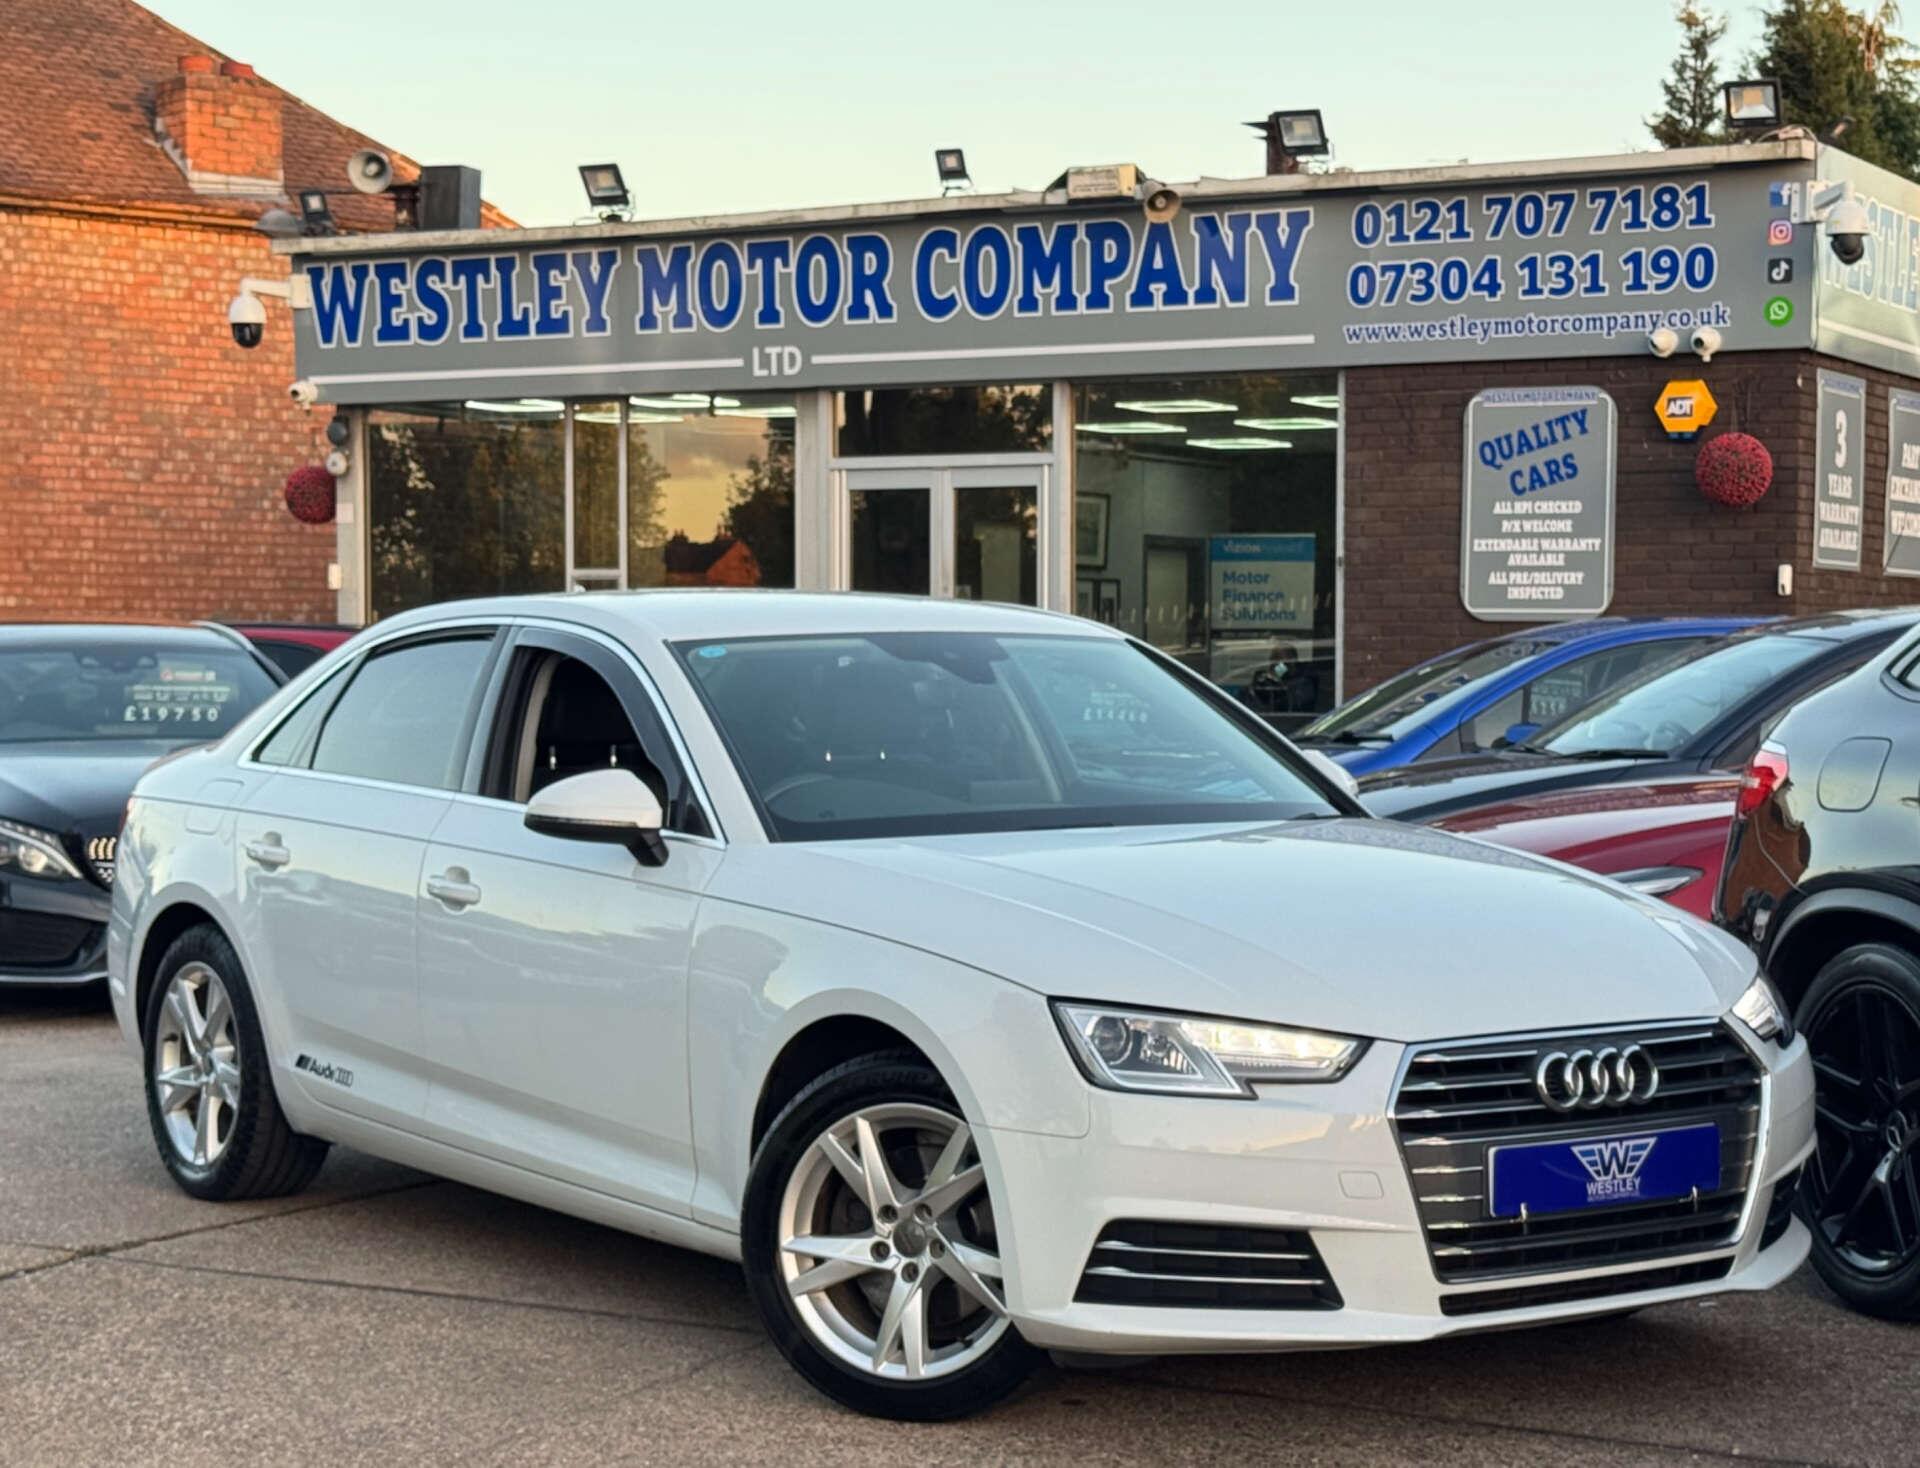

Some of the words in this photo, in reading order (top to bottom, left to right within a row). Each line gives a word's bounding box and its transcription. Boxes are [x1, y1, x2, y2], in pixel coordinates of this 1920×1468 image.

[1352, 195, 1472, 248] 0121
[1482, 189, 1577, 240] 707
[1586, 182, 1716, 235] 7181
[305, 246, 620, 348] WESTLEY
[633, 230, 897, 335] MOTOR
[912, 207, 1314, 324] COMPANY
[1347, 254, 1503, 307] 07304
[1516, 250, 1608, 299] 131
[1620, 245, 1718, 295] 190
[1344, 301, 1731, 344] www.westleymotorcompany.co.uk
[752, 346, 802, 377] LTD
[1667, 399, 1694, 416] ADT
[1479, 408, 1589, 471] QUALITY
[1835, 409, 1847, 469] 3
[1509, 453, 1579, 496] CARS
[1493, 501, 1513, 514] ALL
[1514, 501, 1532, 514] HPI
[1534, 501, 1583, 514] CHECKED
[1522, 520, 1573, 533] WELCOME
[1473, 539, 1539, 552] EXTENDABLE
[1540, 538, 1602, 551] WARRANTY
[1507, 553, 1565, 566] AVAILABLE
[1222, 572, 1270, 584] Motor
[1488, 572, 1507, 585] ALL
[1509, 572, 1584, 585] PRE/DELIVERY
[1222, 589, 1285, 602] Finance
[1507, 587, 1564, 599] INSPECTED
[1222, 607, 1296, 621] Solutions
[124, 705, 219, 722] £19750
[1586, 1176, 1641, 1196] WESTLEY
